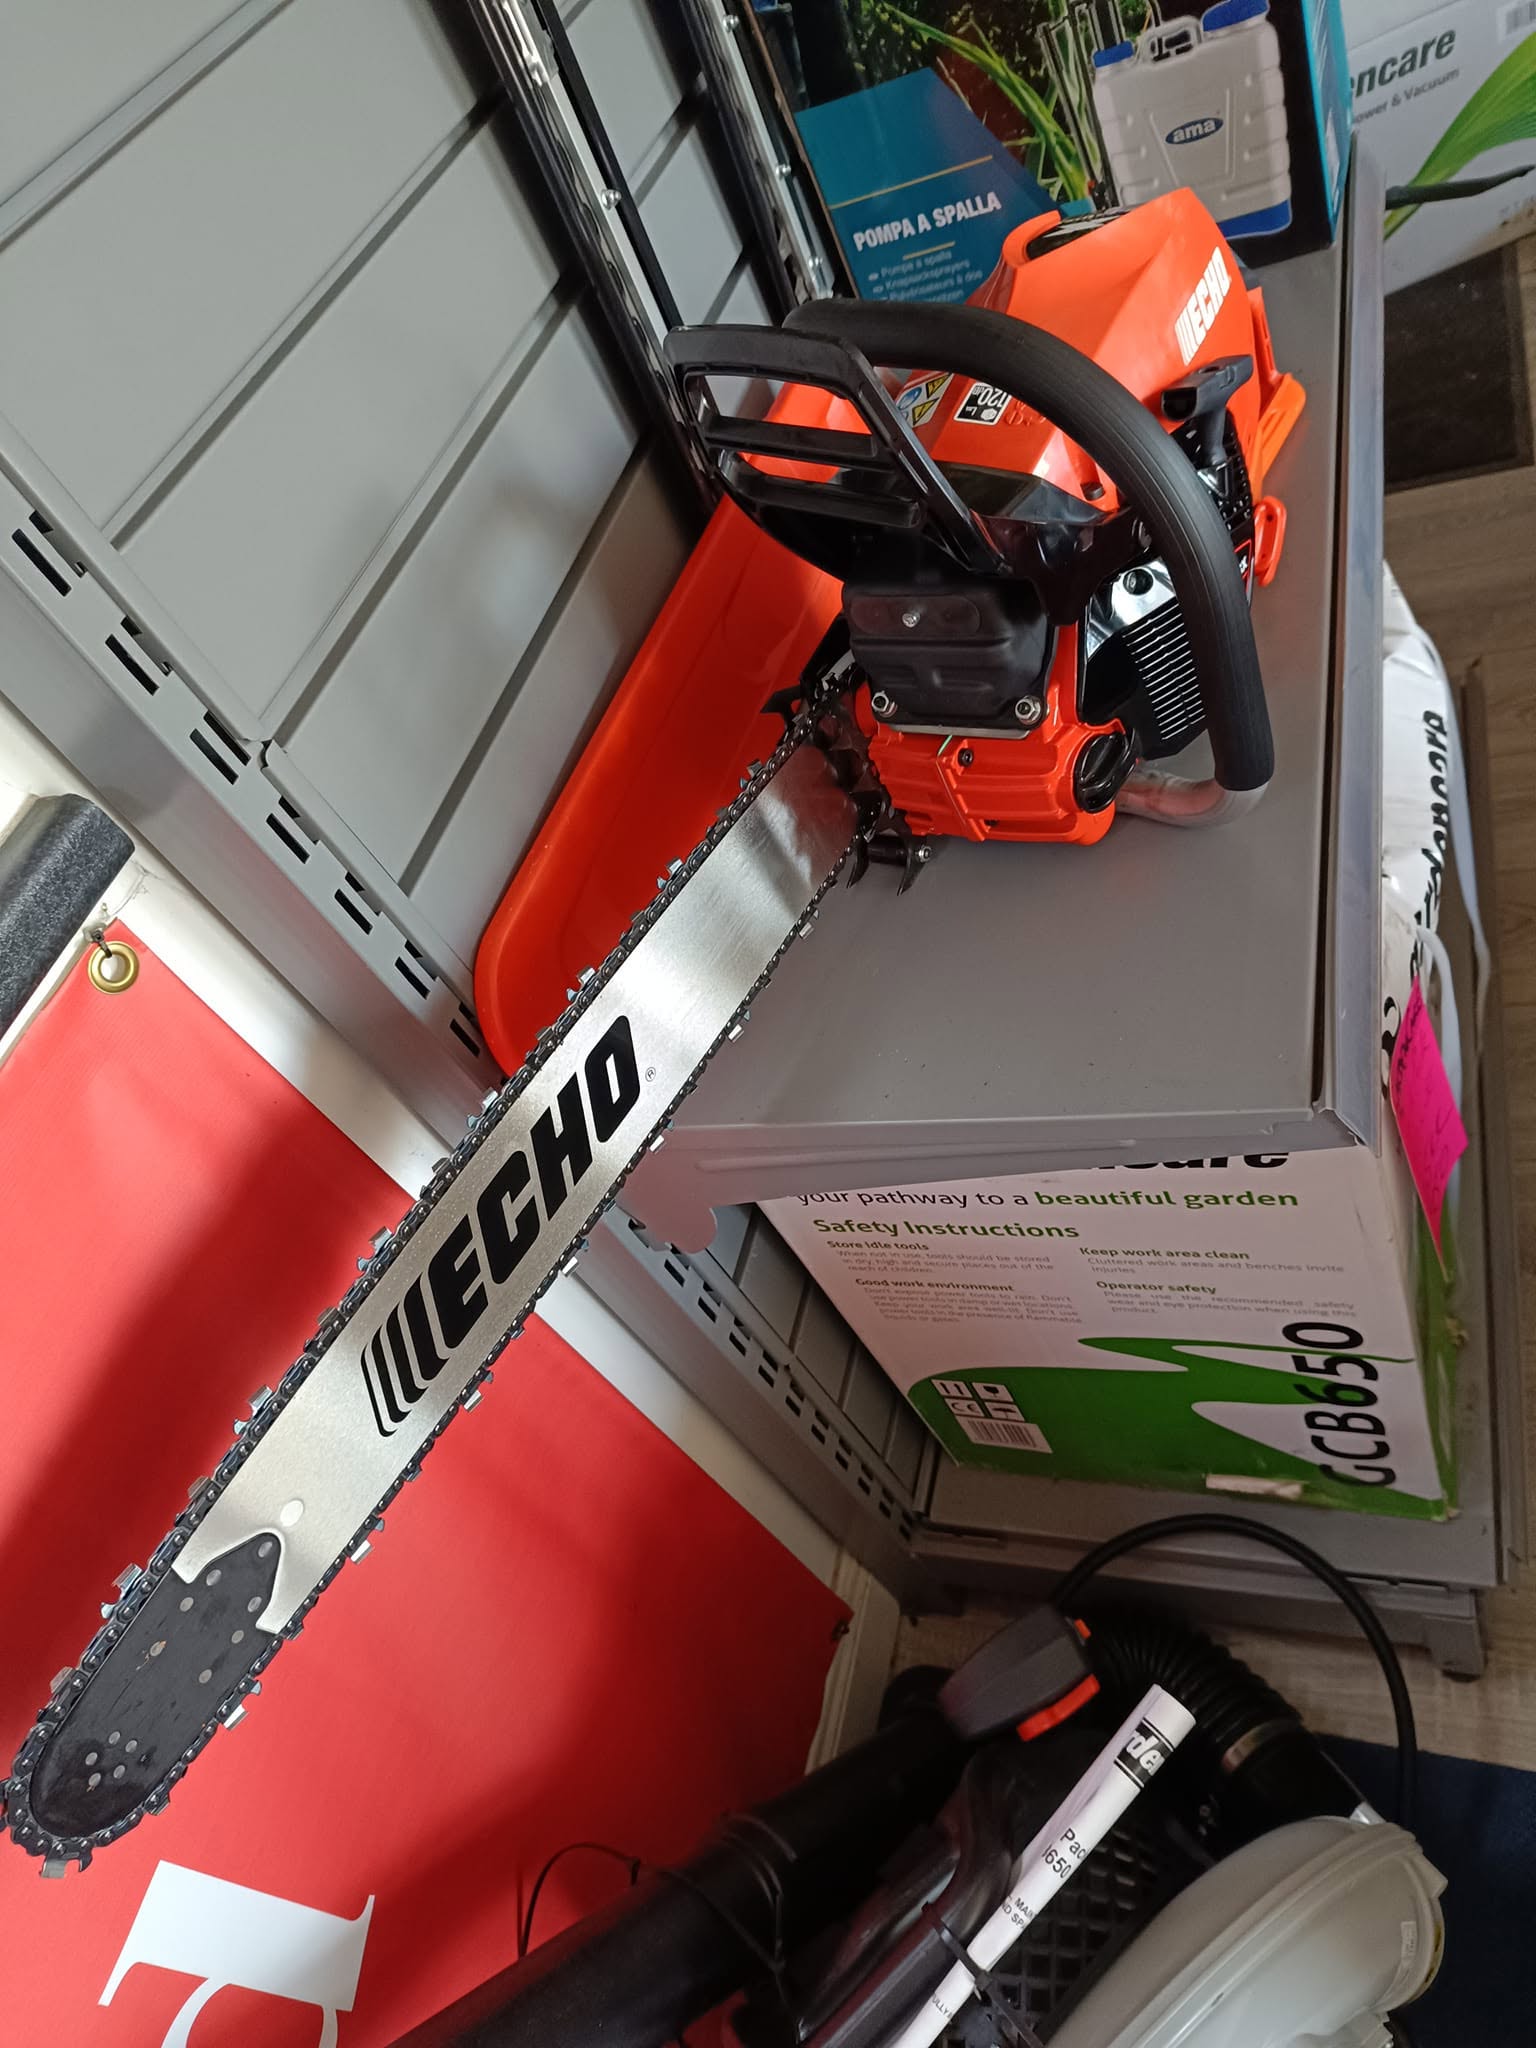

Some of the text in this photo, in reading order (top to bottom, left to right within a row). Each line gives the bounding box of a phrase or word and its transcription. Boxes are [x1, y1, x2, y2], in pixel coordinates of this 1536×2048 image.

[1404, 69, 1460, 100] Vacuum
[1173, 119, 1216, 143] ama
[853, 191, 1002, 252] POMPA A SPALLA
[1180, 246, 1231, 356] ECHO
[395, 1015, 640, 1390] ECHO
[796, 1191, 1299, 1209] your pathway to a beautiful garden
[814, 1220, 1080, 1238] Safety Instructions
[827, 1240, 862, 1250] Store
[894, 1242, 929, 1251] tools
[1080, 1247, 1250, 1260] Keep work area clean
[855, 1278, 1014, 1291] Good work environment
[1096, 1280, 1217, 1294] Operator safety
[1282, 1322, 1396, 1486] GCB650
